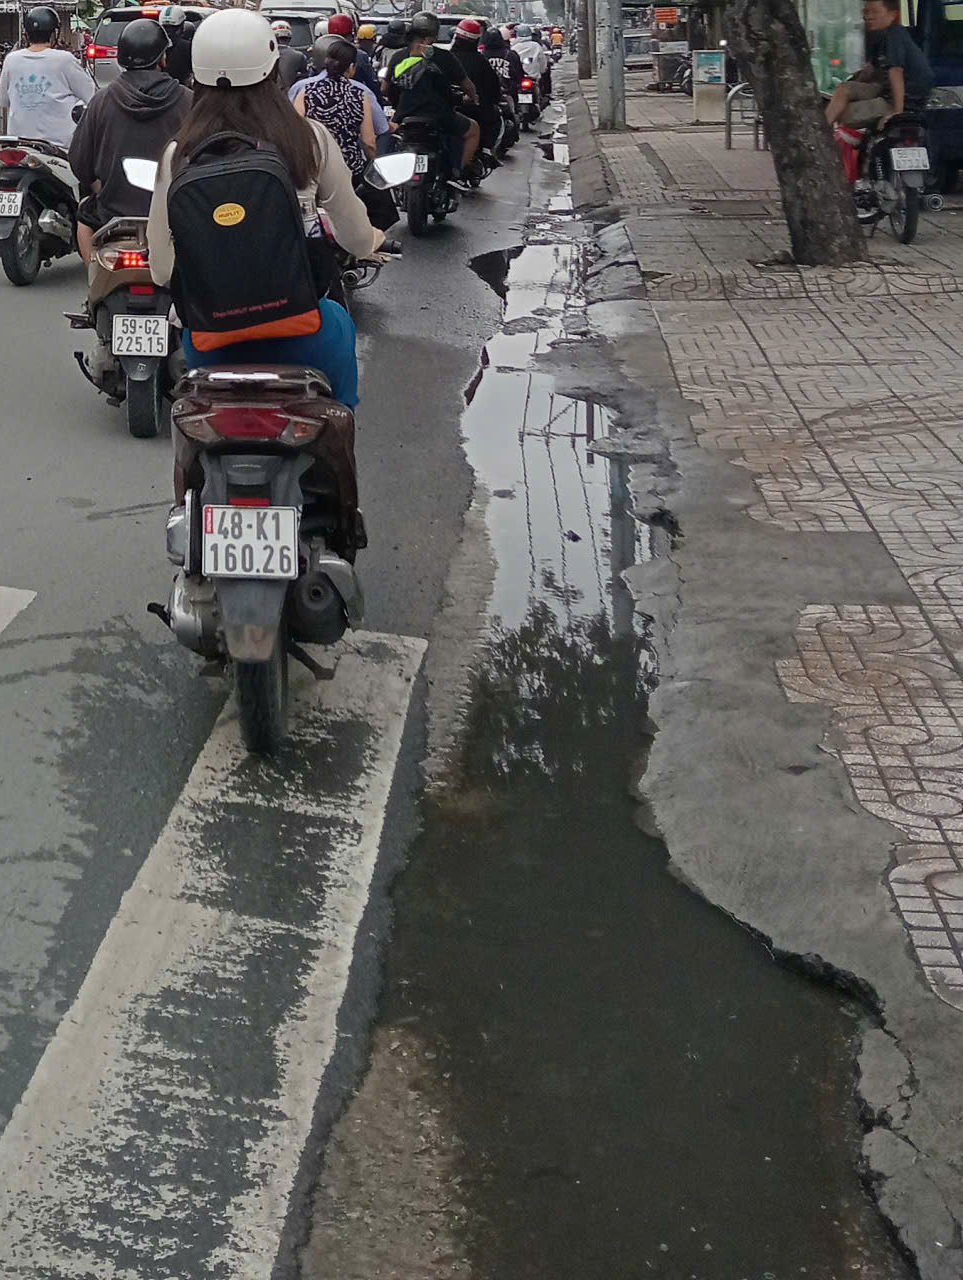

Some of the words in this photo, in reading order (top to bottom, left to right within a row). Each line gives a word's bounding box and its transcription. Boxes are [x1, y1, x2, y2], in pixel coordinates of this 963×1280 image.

[121, 318, 160, 335] 59-G2
[116, 336, 164, 353] 225.15
[217, 511, 281, 541] 48-K1
[210, 543, 292, 574] 160.26
